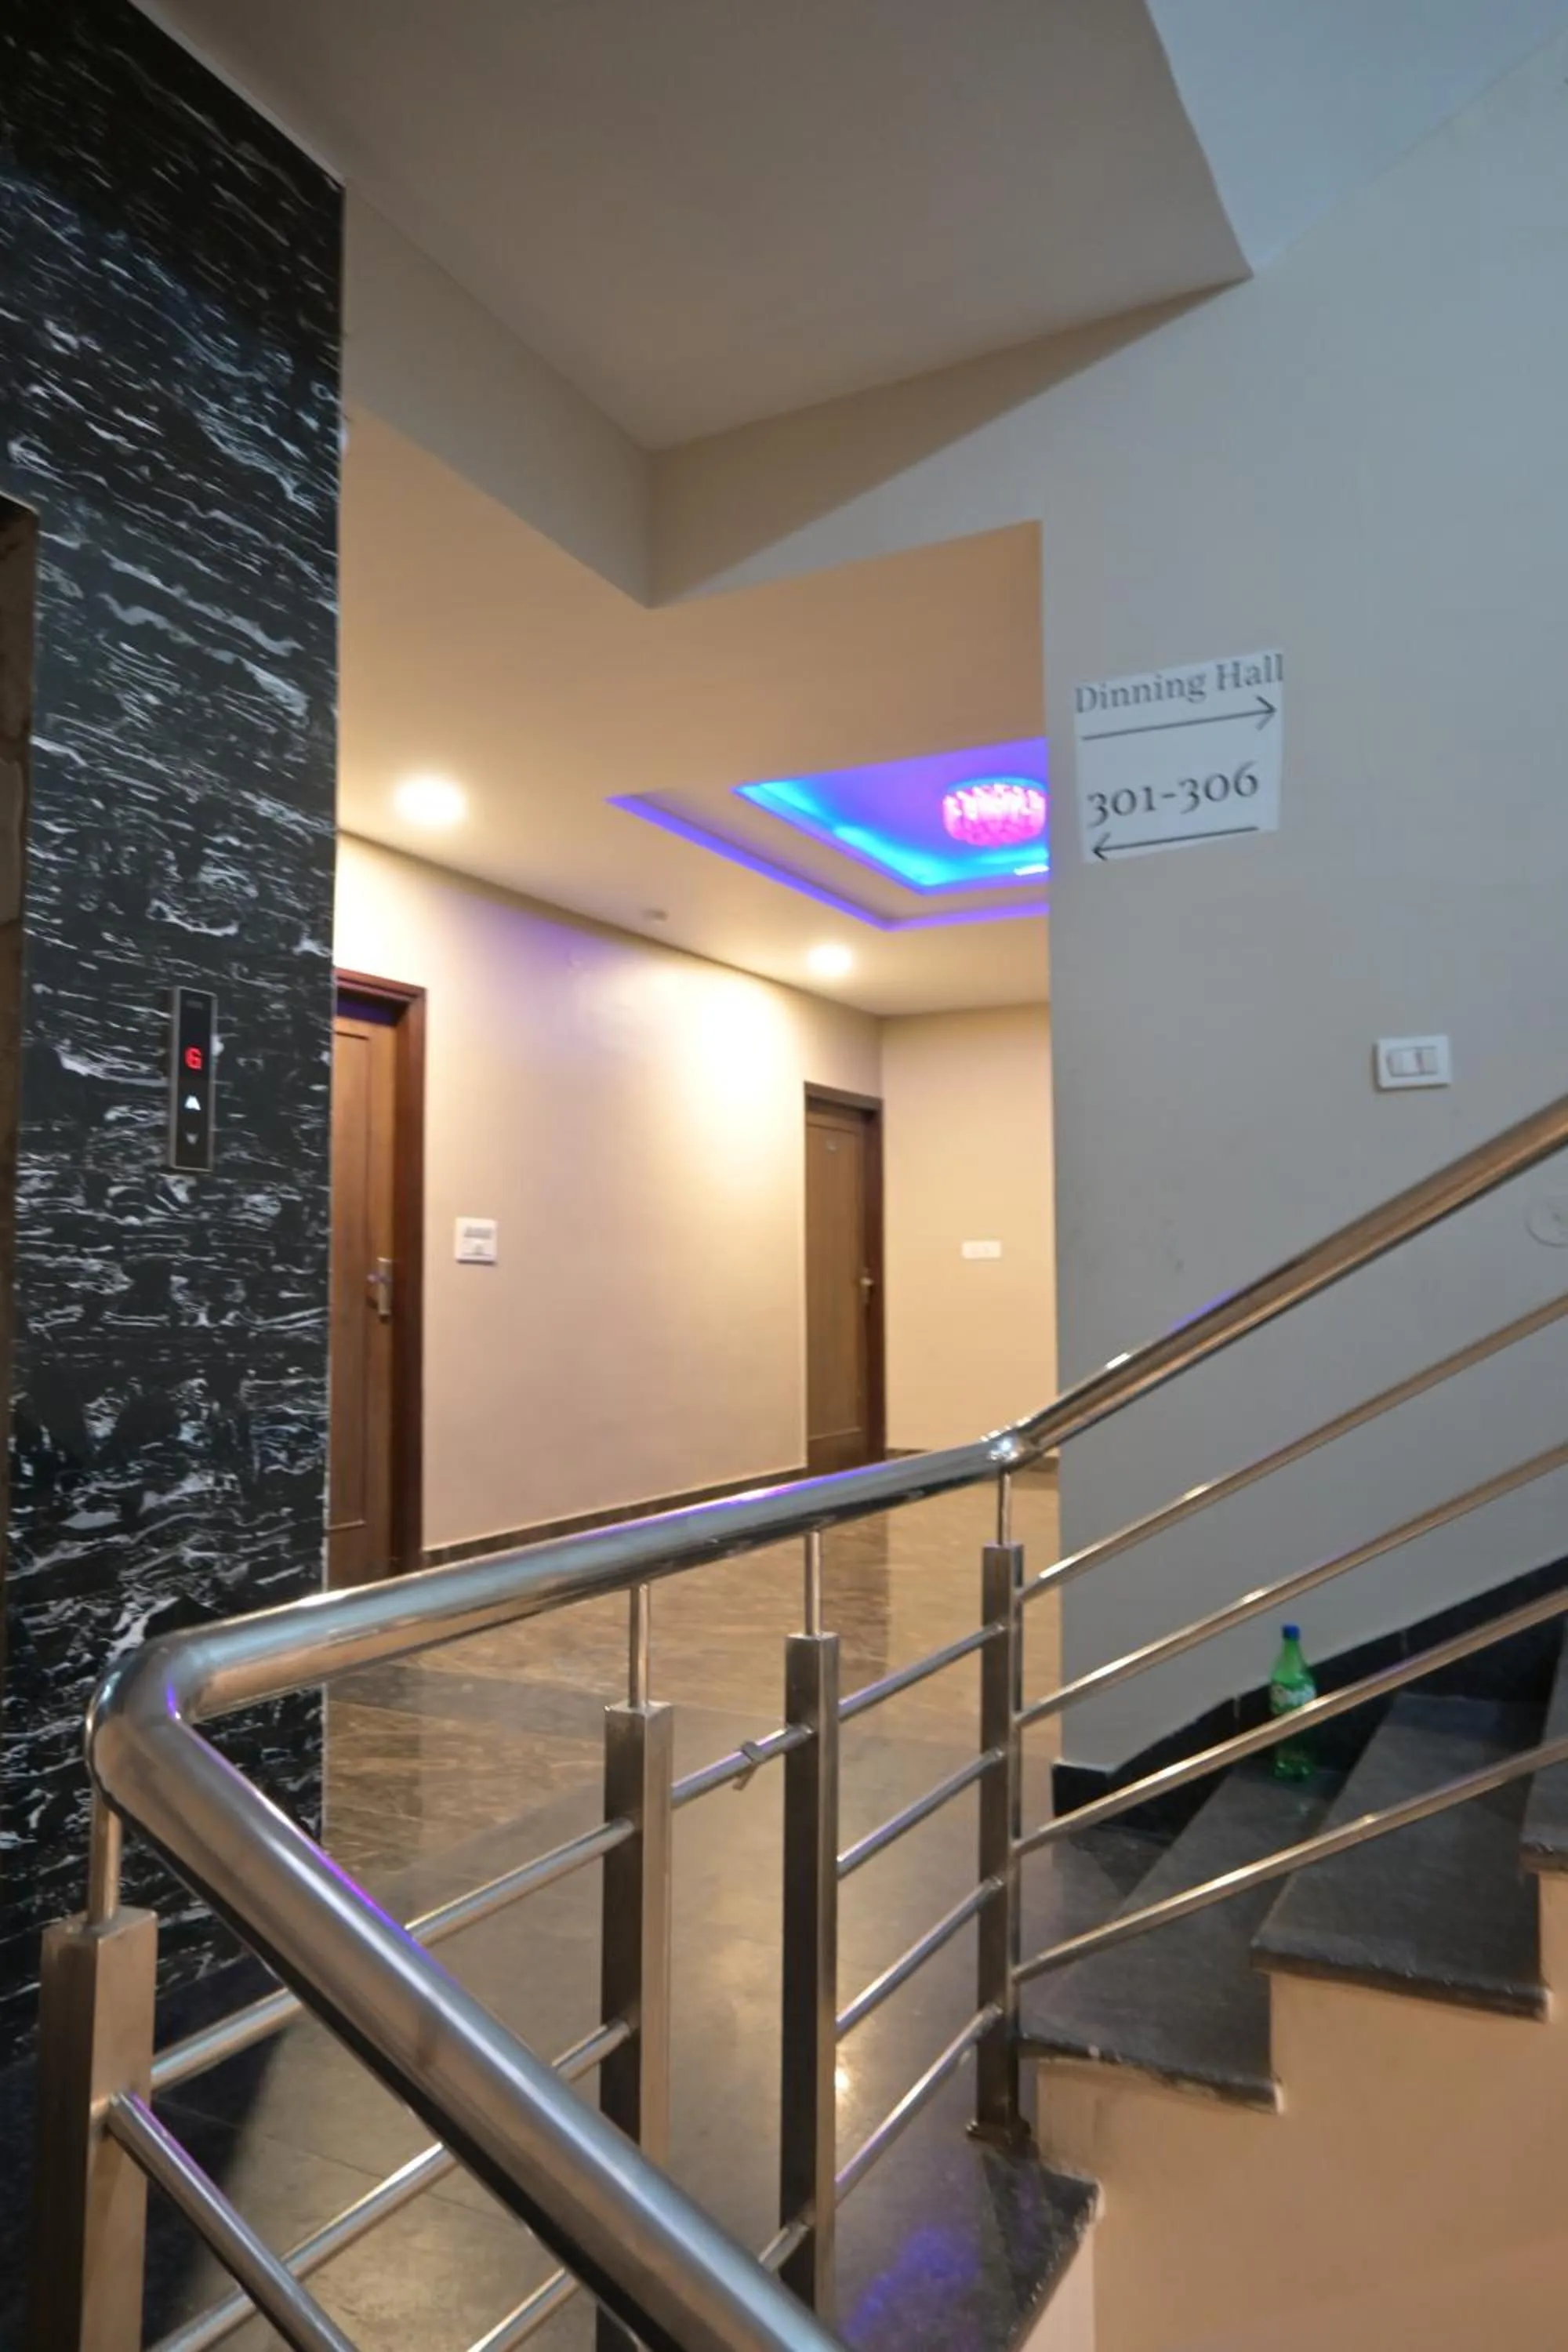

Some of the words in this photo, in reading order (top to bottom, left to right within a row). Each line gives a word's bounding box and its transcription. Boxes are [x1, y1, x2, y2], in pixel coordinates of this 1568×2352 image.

[1075, 673, 1207, 713] Dinning
[1216, 653, 1283, 691] Hall
[1087, 760, 1259, 829] 301-306
